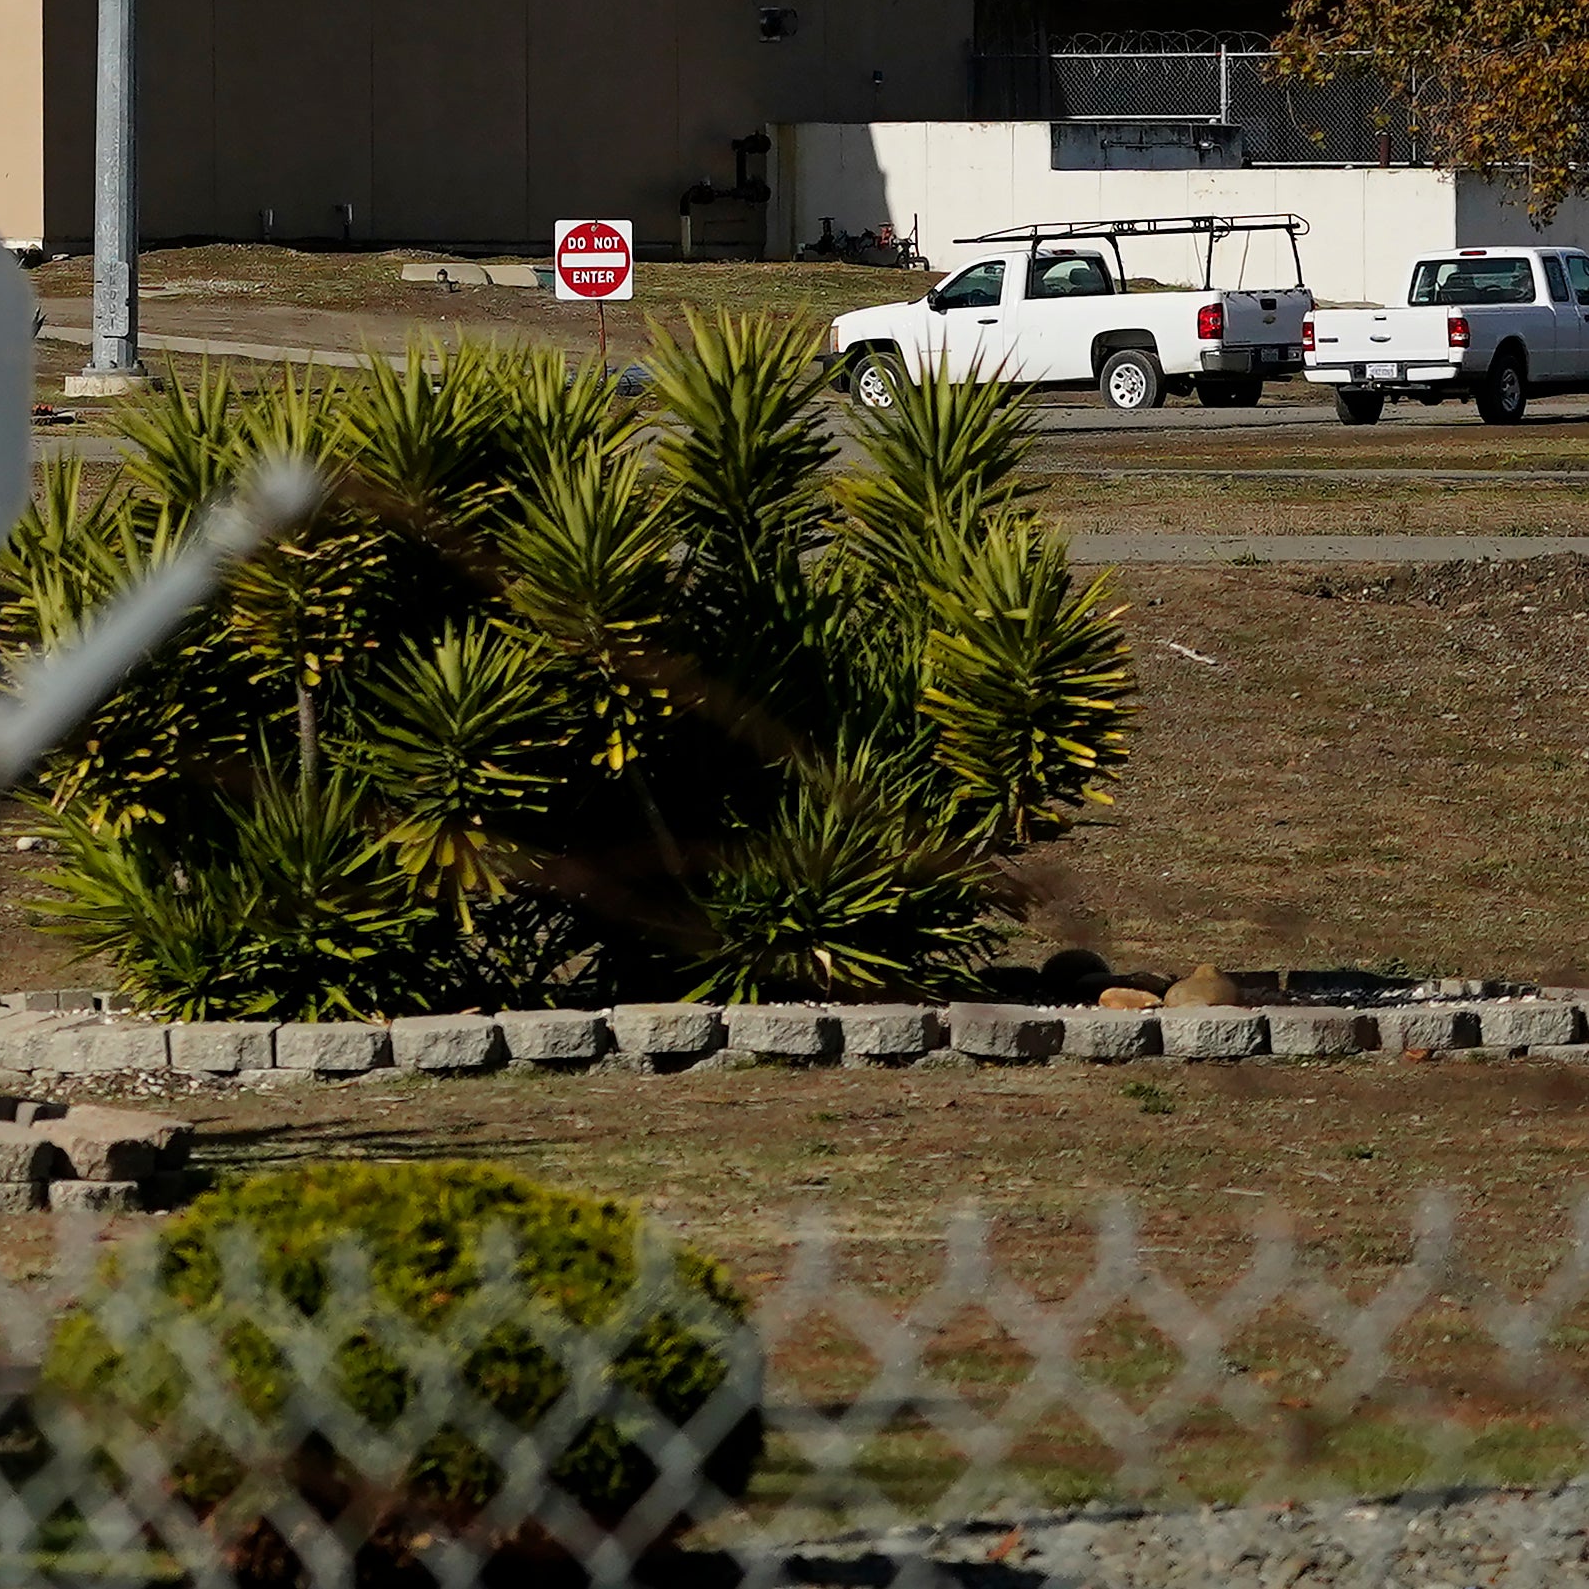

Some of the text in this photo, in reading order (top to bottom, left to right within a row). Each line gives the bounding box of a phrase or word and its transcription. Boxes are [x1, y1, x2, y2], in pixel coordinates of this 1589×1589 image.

[567, 236, 620, 250] DO NOT
[572, 270, 615, 284] ENTER
